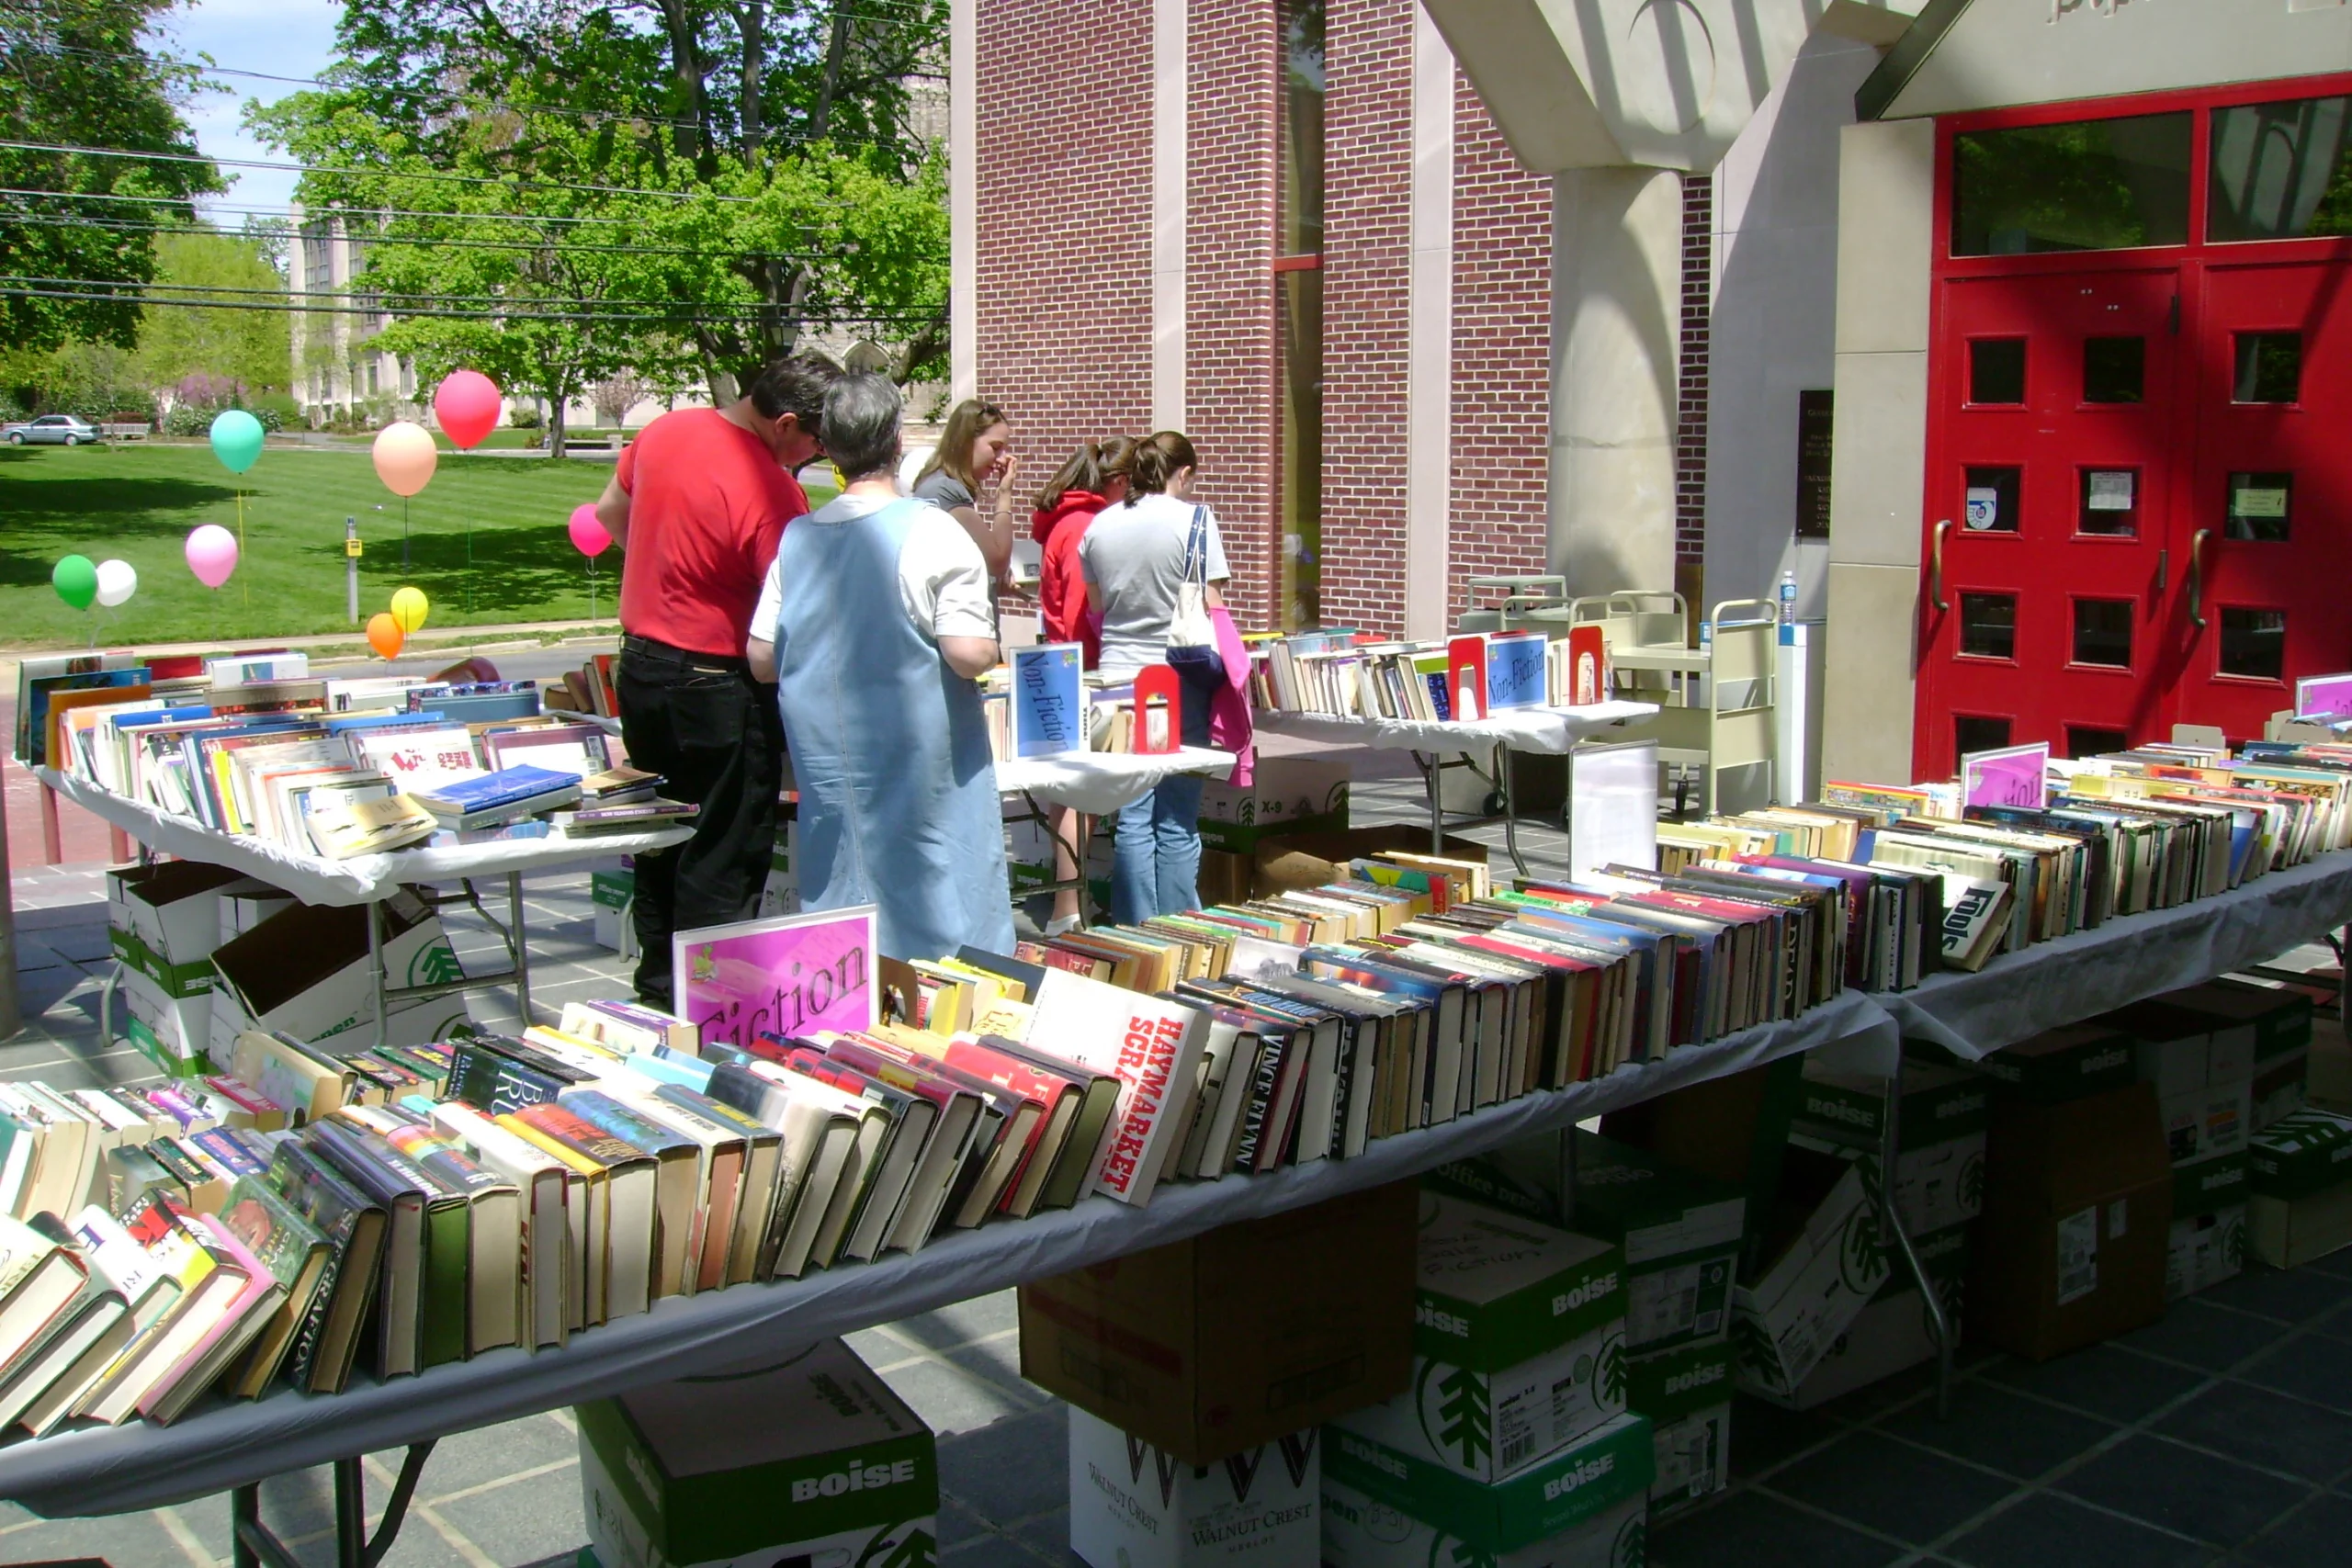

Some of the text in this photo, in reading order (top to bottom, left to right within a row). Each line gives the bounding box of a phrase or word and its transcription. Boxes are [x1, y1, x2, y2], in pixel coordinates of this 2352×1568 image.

[1021, 651, 1069, 752] Non-Fiction
[1488, 649, 1544, 704] Non-Fiction
[1262, 800, 1283, 814] X-9
[2002, 772, 2042, 807] tion
[1942, 887, 1996, 954] Fools
[1102, 1016, 1184, 1194] HAYMARKET
[1235, 1033, 1285, 1166] VINCE FLYNN
[1435, 1163, 1496, 1197] Office
[293, 1259, 339, 1381] GRAFTON
[1088, 1461, 1159, 1536] WALNUT CREST
[1191, 1503, 1314, 1549] WALNUT CREST
